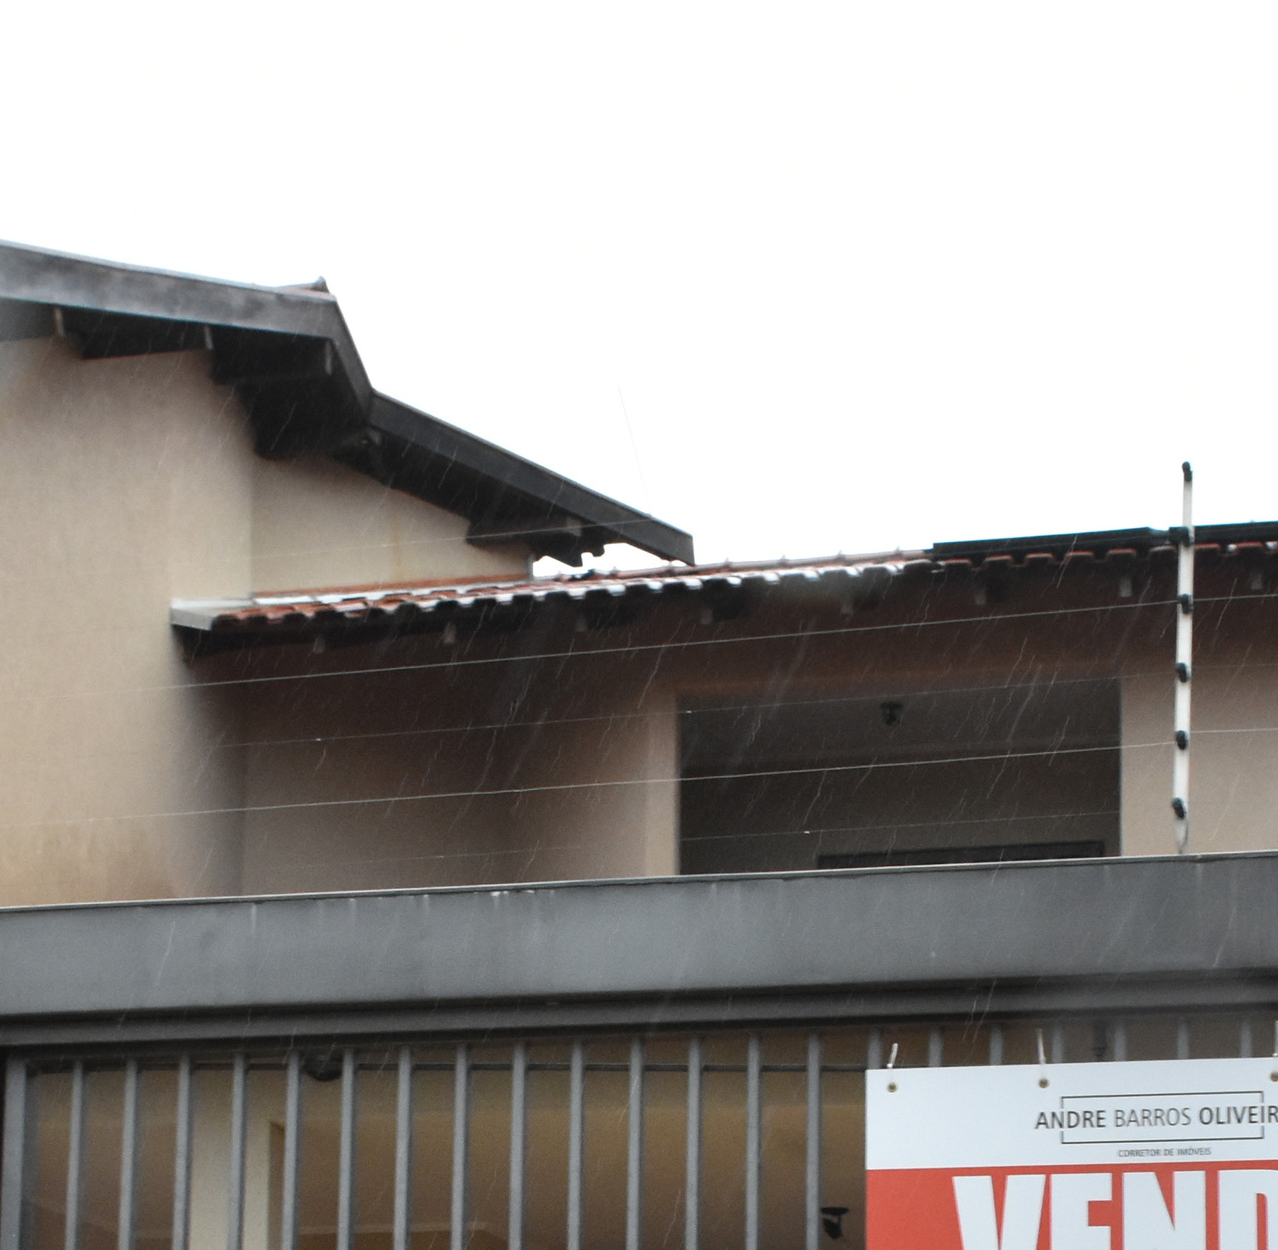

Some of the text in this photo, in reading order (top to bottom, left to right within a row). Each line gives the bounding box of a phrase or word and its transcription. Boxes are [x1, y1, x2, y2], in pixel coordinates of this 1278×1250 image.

[1034, 1109, 1106, 1130] ANDRE
[1114, 1107, 1192, 1127] BARROS
[1118, 1146, 1211, 1158] CORRETOR DE IMÓVEIS
